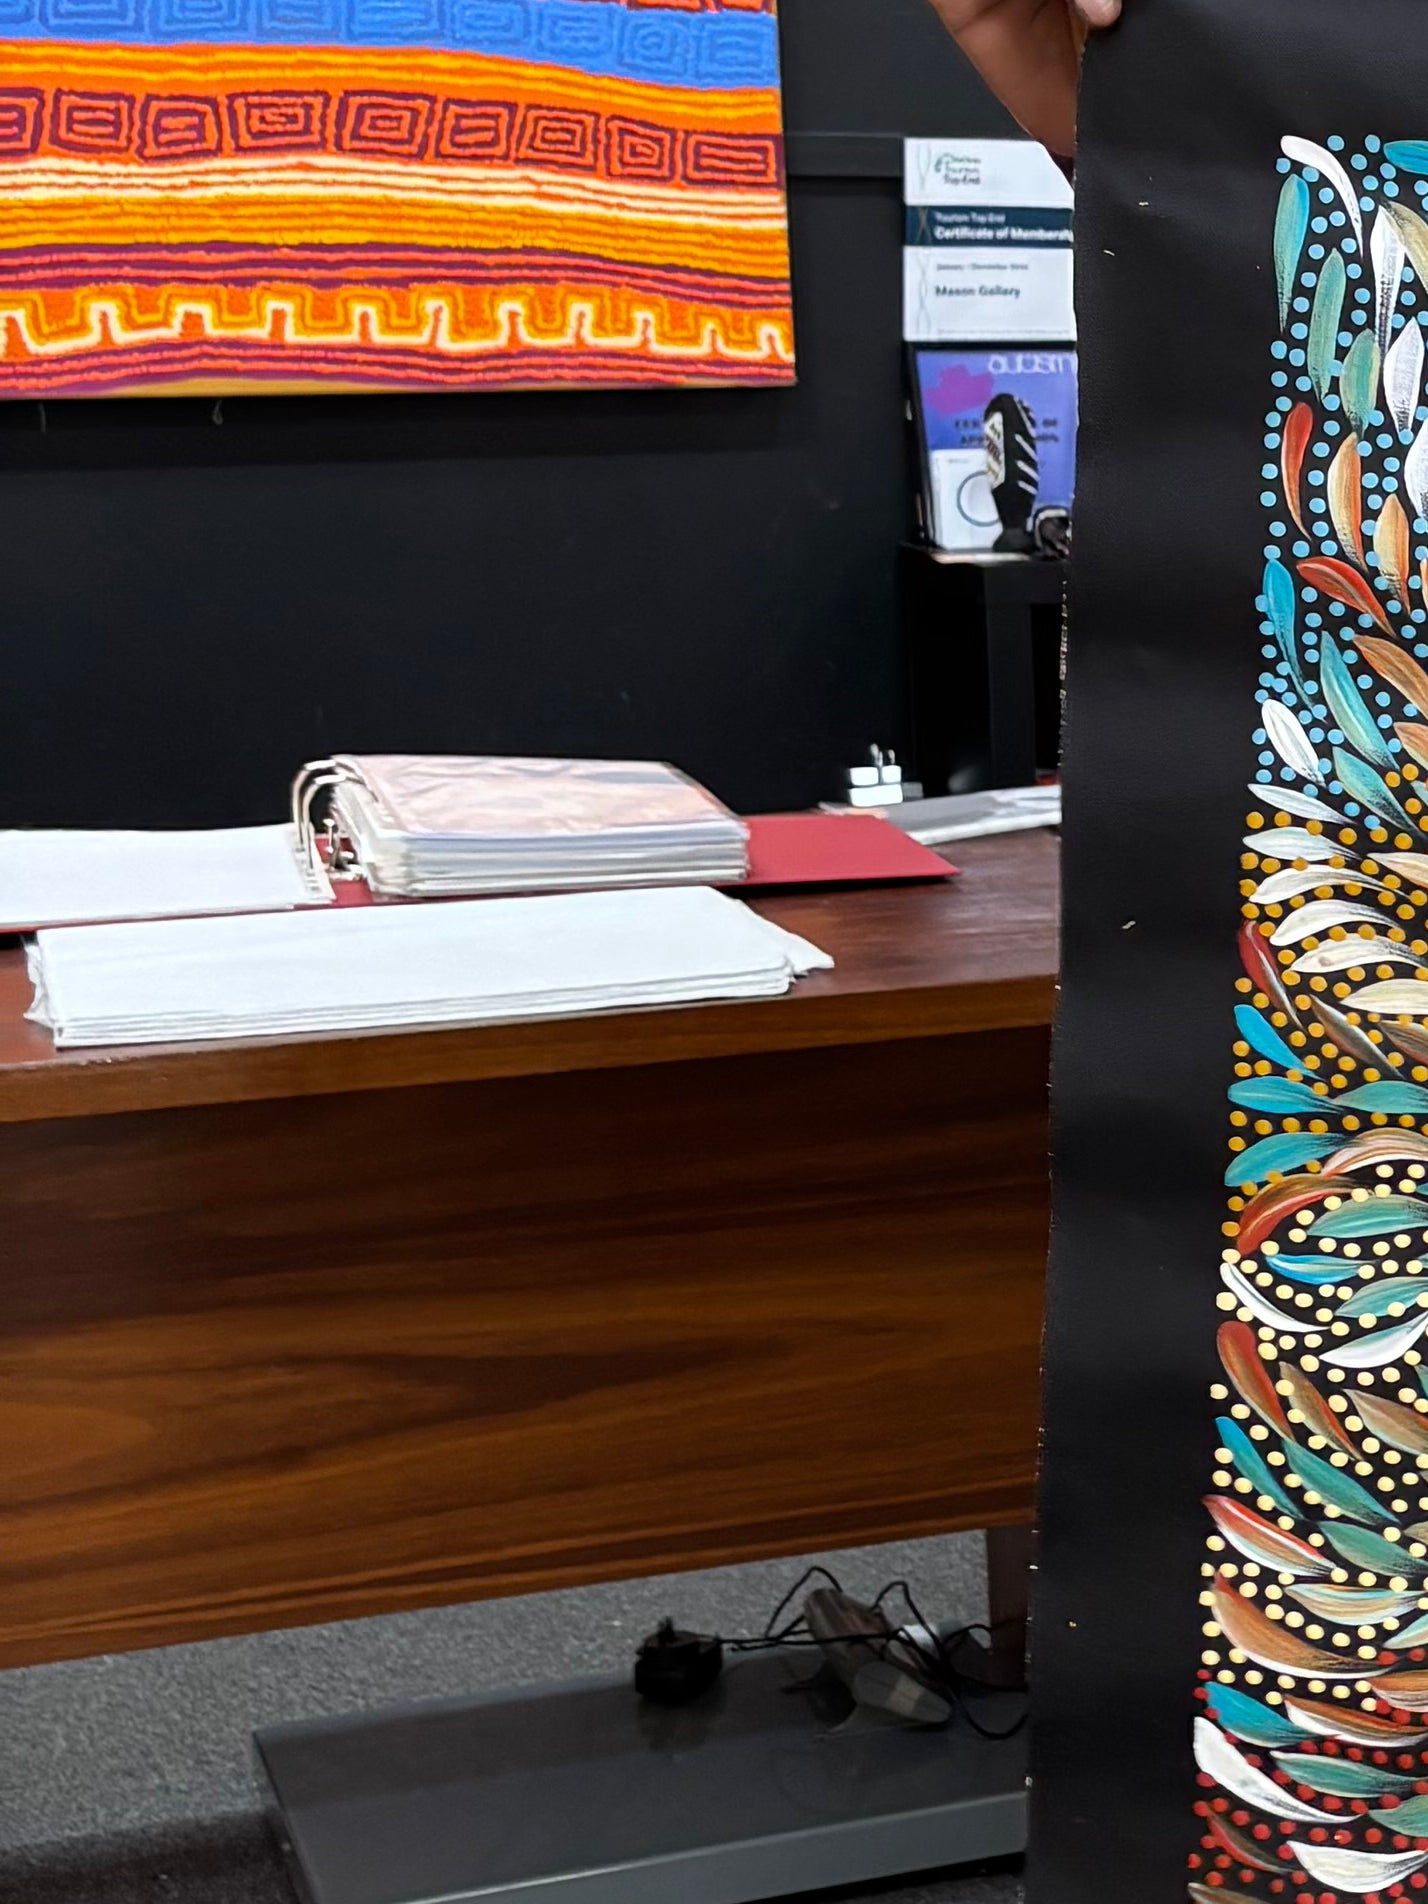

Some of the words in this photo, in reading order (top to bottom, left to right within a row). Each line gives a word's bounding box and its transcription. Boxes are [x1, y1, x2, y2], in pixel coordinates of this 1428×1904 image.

[934, 225, 994, 240] Certificate
[995, 226, 1009, 240] of
[1010, 226, 1073, 241] Membersh
[935, 285, 975, 297] Mason
[979, 284, 1020, 299] Gallery
